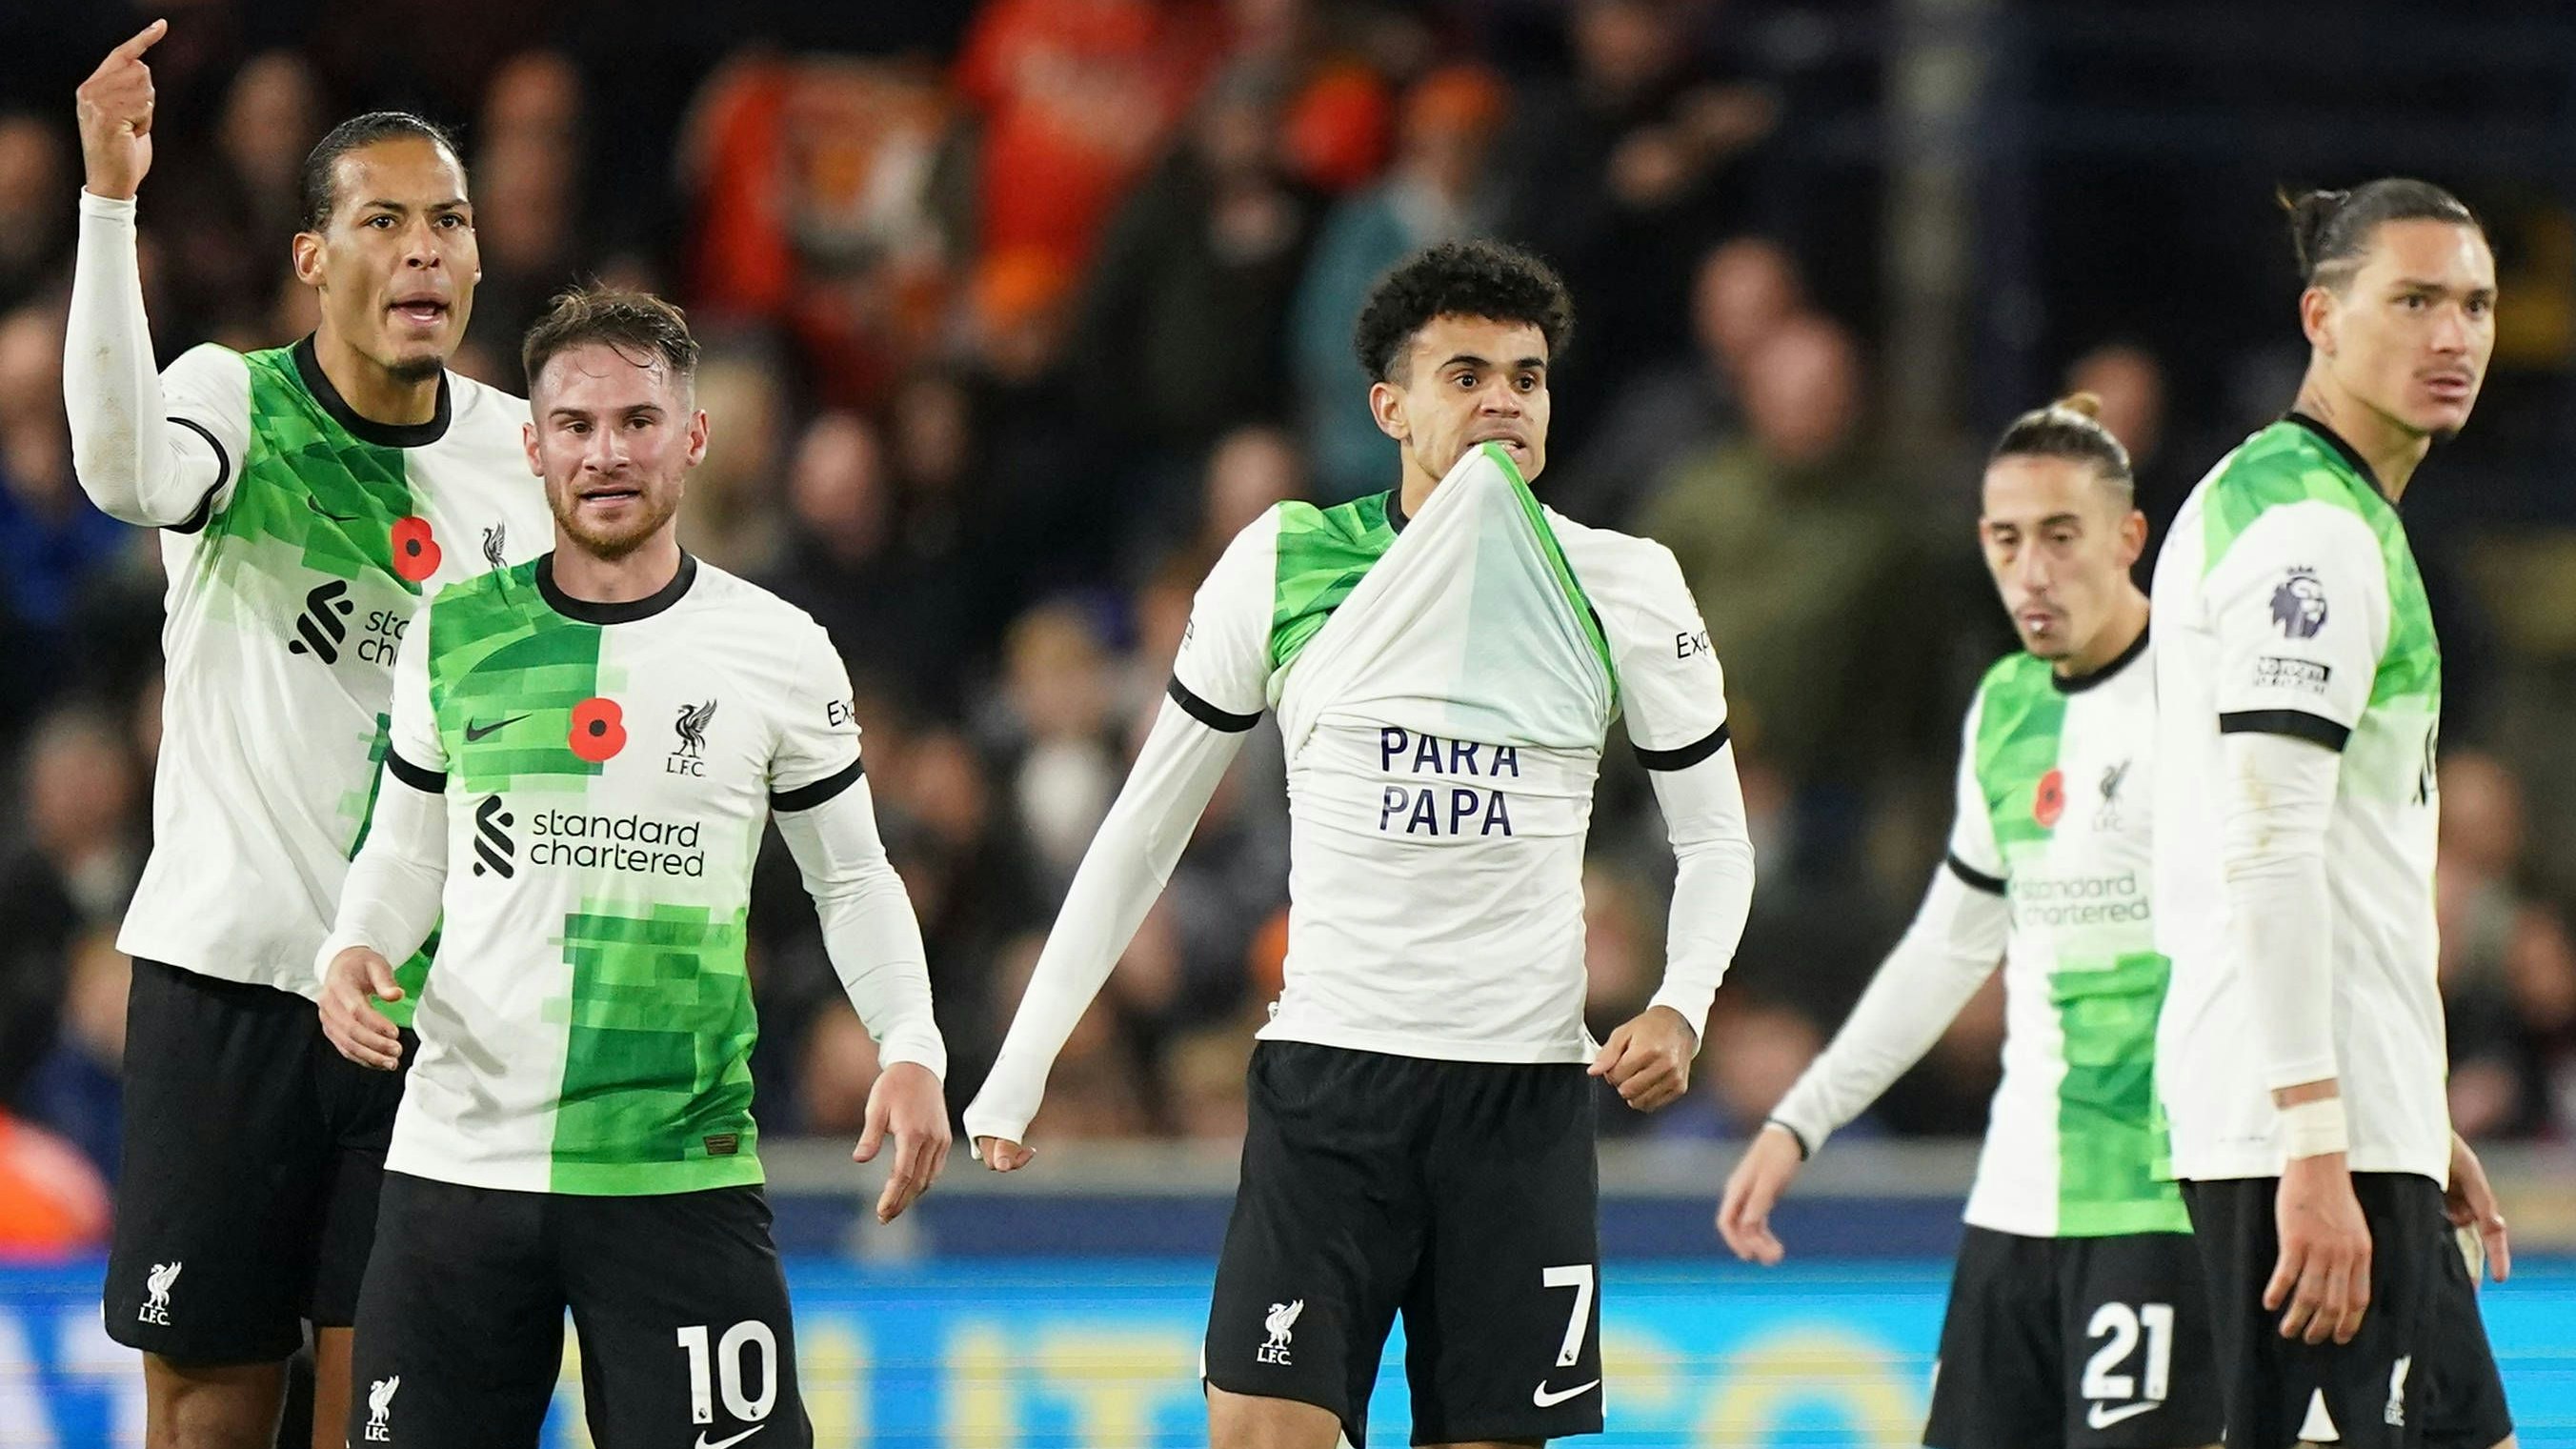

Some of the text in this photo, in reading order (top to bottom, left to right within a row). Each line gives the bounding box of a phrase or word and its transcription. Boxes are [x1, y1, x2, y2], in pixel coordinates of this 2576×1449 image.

[1380, 727, 1519, 777] PARA
[533, 809, 701, 849] standard
[1379, 786, 1513, 836] PAPA
[530, 838, 705, 877] chartered
[1542, 1263, 1595, 1367] 7
[676, 1319, 777, 1424] 10
[2081, 1301, 2174, 1400] 21
